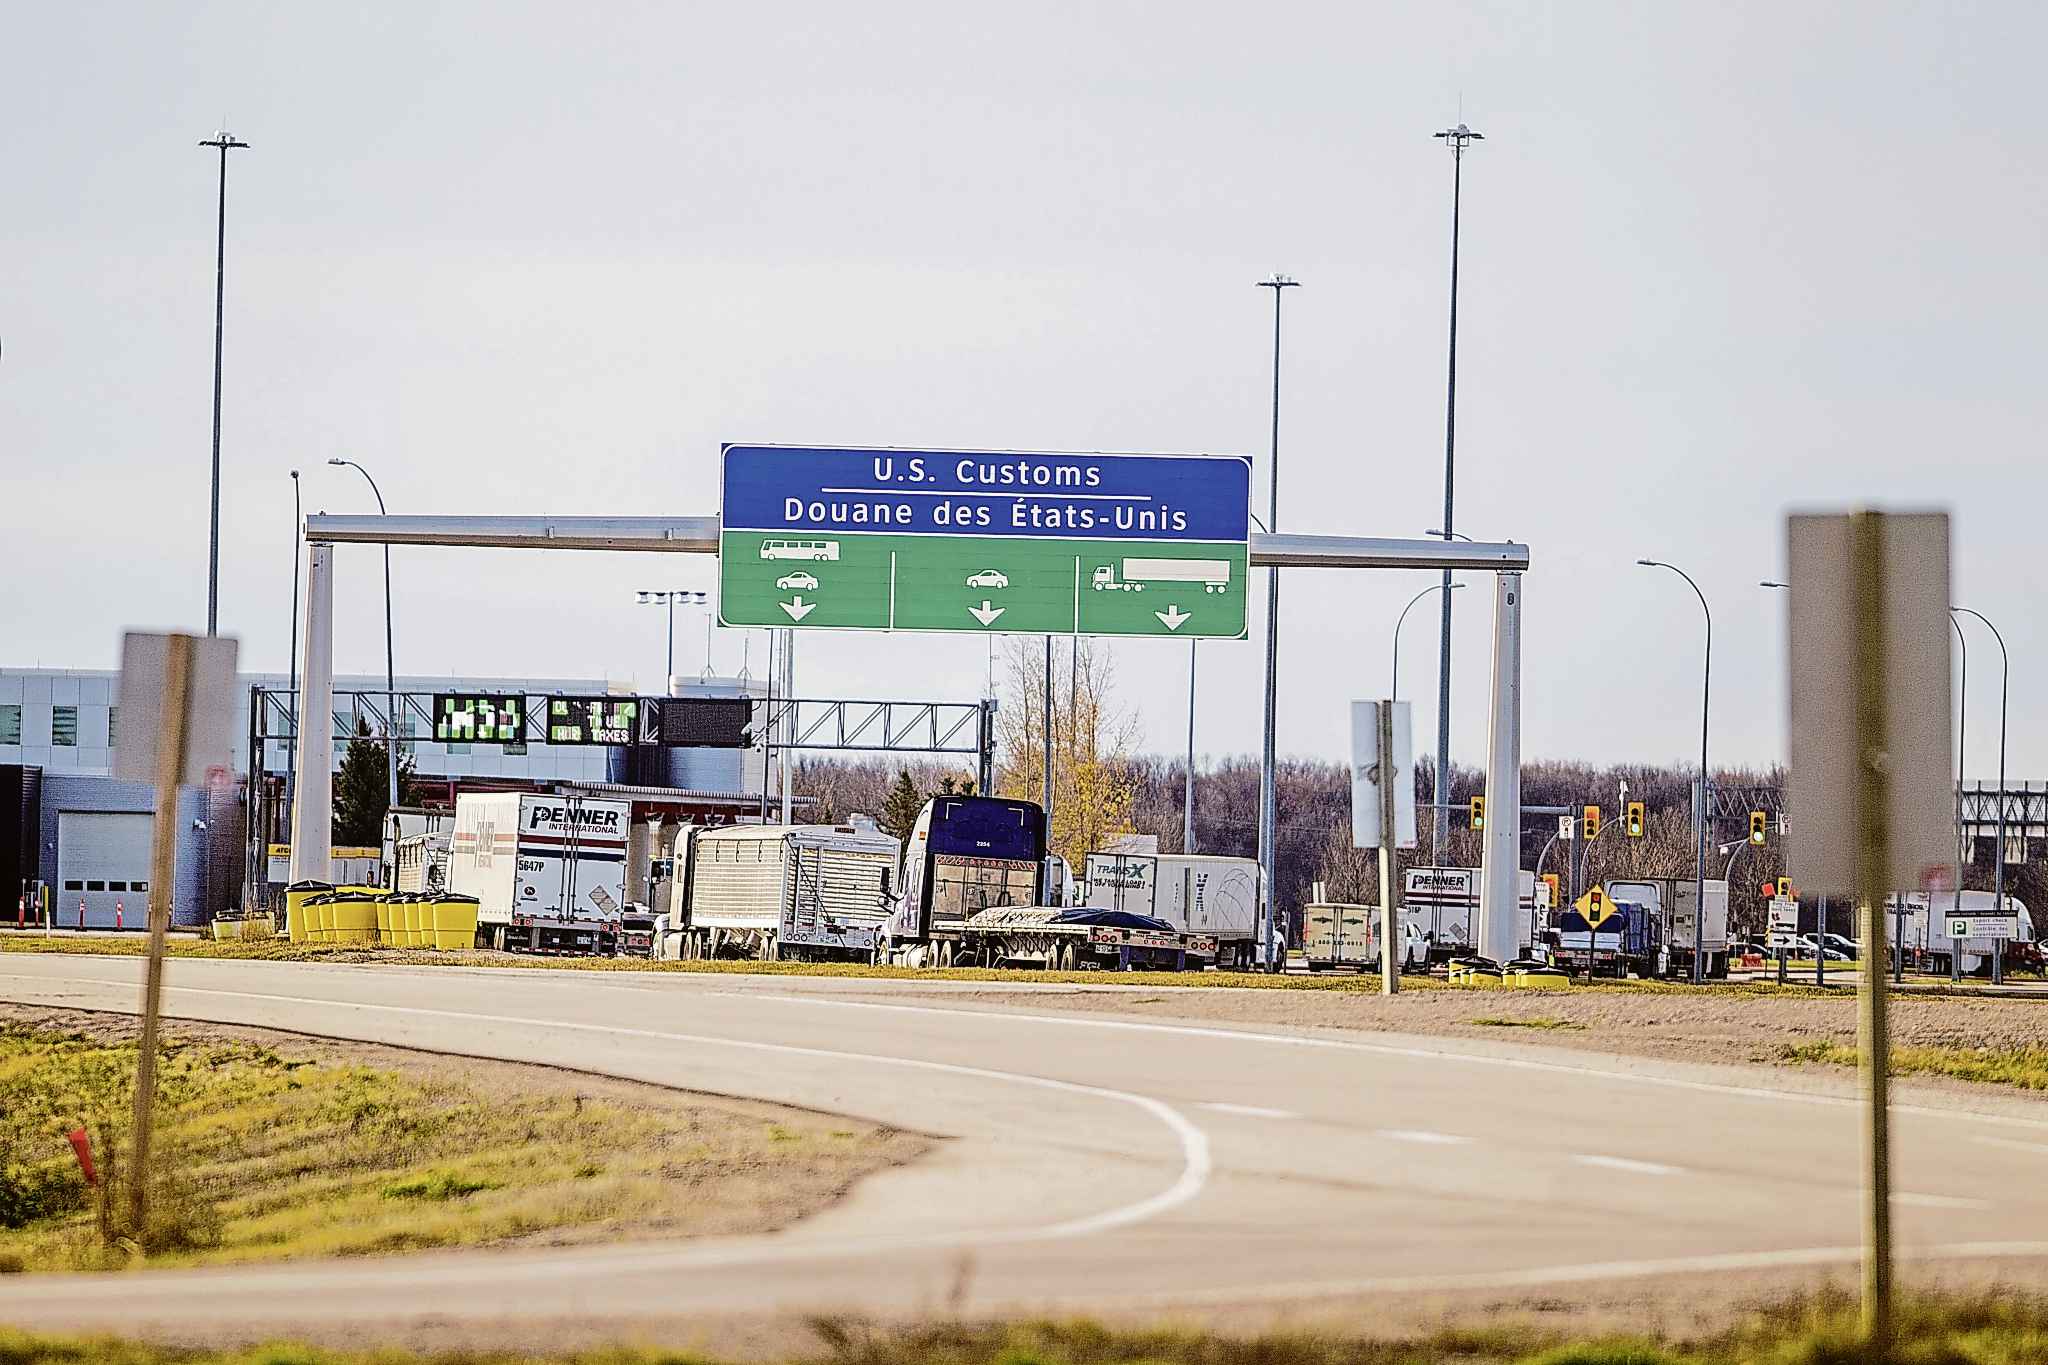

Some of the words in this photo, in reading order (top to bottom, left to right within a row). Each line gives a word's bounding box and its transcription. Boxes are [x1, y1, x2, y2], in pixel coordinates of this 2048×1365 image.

[873, 457, 936, 483] U.S.
[956, 459, 1101, 487] Customs
[784, 497, 914, 525] Douane
[932, 500, 992, 526] des
[1012, 497, 1188, 532] États-Unis
[590, 728, 630, 743] TAXES
[529, 805, 619, 829] PENNER
[548, 822, 619, 835] INTERNATIONAL
[518, 860, 545, 872] 5647P
[1411, 874, 1465, 889] PENNER
